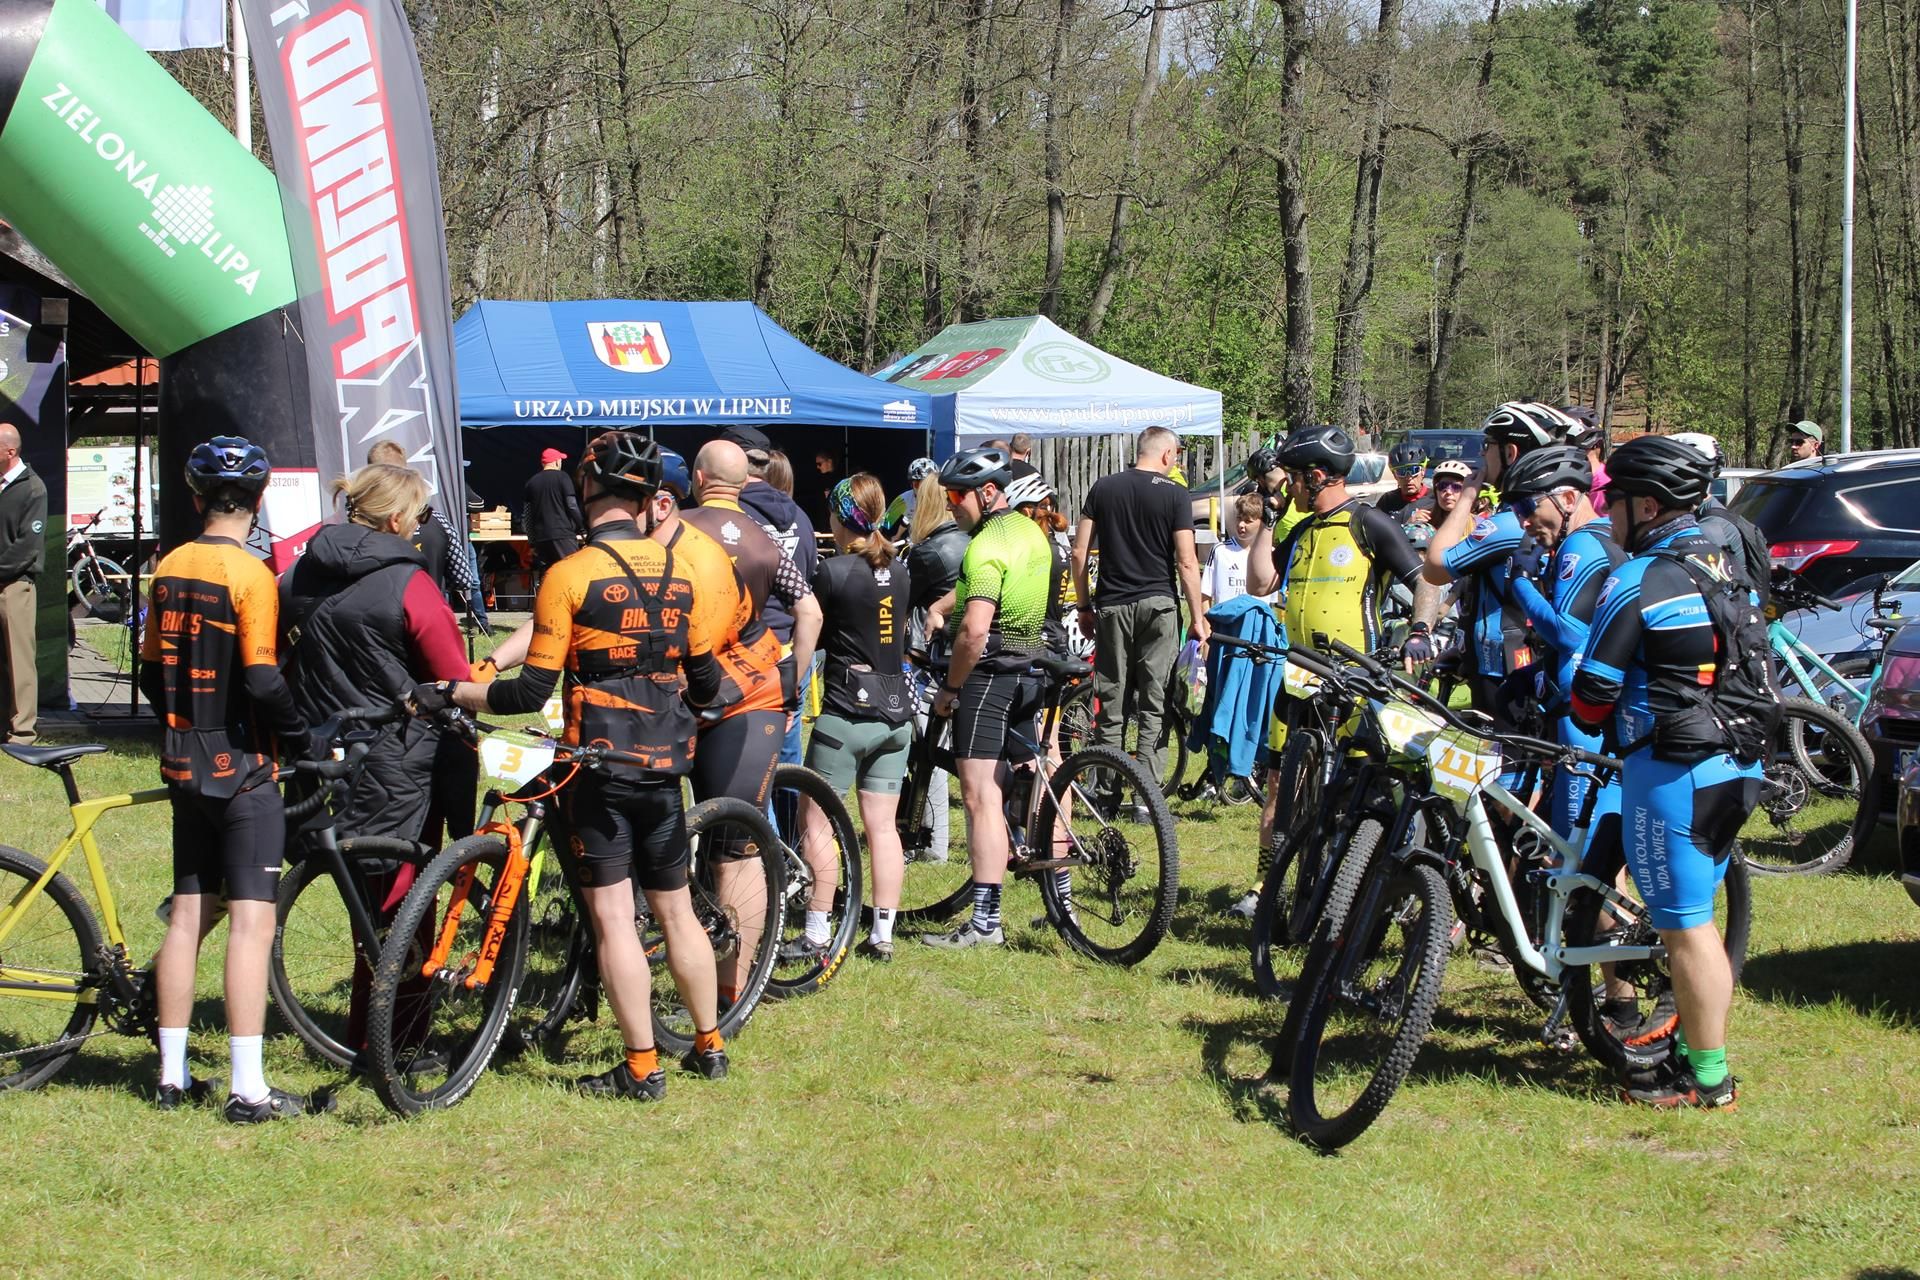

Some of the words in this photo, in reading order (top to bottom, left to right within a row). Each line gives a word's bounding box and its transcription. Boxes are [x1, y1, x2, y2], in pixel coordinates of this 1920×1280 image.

[42, 82, 165, 200] ZIELONA
[200, 231, 262, 297] LIPA
[514, 400, 593, 422] URZĄD
[599, 398, 687, 421] MIEJSKI
[691, 398, 715, 416] W
[719, 397, 792, 416] LIPNIE
[990, 402, 1194, 427] www.puklipno.pl
[879, 595, 893, 635] LIPA
[609, 646, 637, 660] RACE
[499, 746, 524, 774] 3
[1435, 746, 1486, 784] 111
[756, 771, 770, 802] JAWORSKI
[1635, 806, 1648, 865] KOLARSKI
[1650, 818, 1666, 862] ŚWIECIE
[1637, 865, 1656, 897] KLUB
[1656, 864, 1671, 891] WDA
[485, 926, 504, 962] FOX
[761, 944, 780, 984] RABBIT
